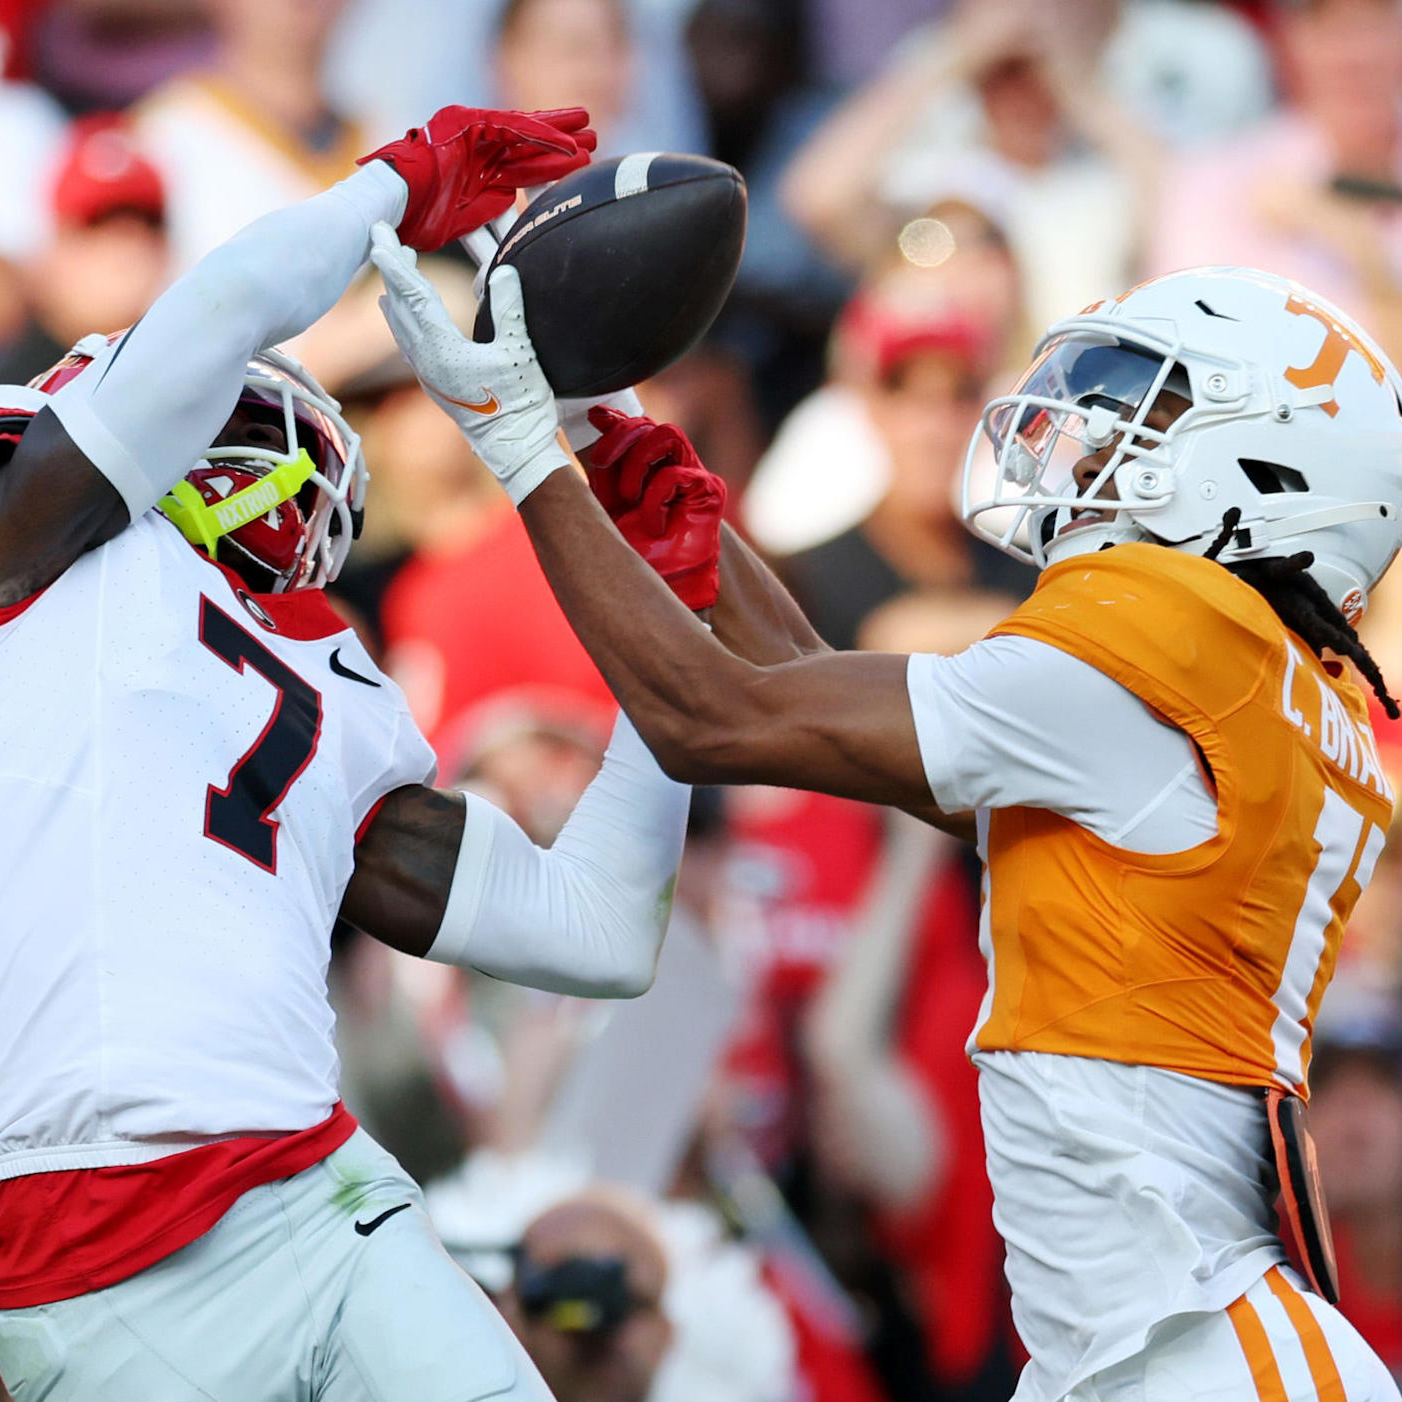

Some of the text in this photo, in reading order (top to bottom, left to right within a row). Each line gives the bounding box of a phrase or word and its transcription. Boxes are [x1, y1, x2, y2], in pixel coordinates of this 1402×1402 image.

[1283, 293, 1386, 420] T
[214, 480, 280, 531] NXTRND
[198, 591, 323, 876] 7
[1281, 637, 1313, 738] C.
[1269, 784, 1387, 1092] 1
